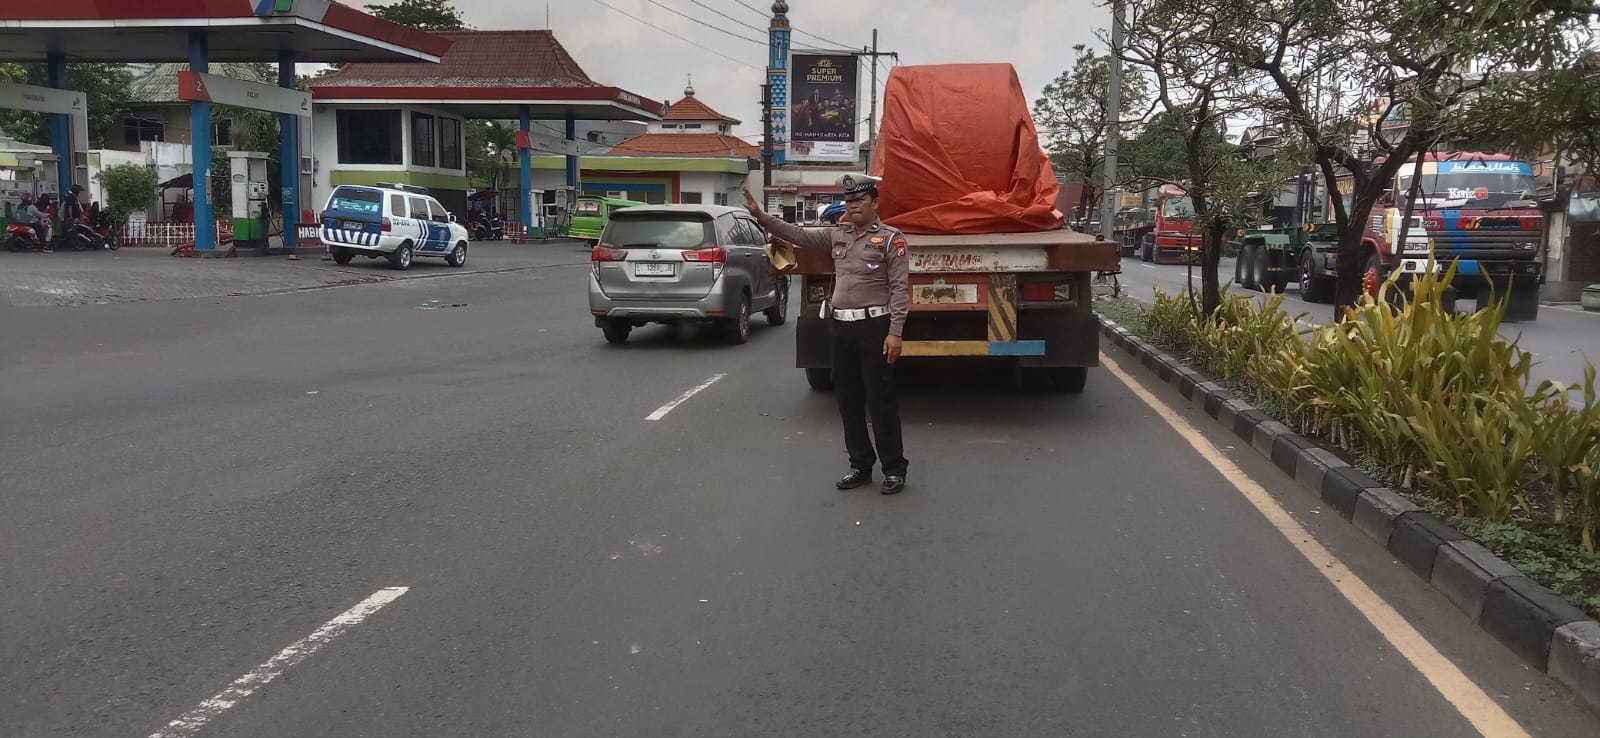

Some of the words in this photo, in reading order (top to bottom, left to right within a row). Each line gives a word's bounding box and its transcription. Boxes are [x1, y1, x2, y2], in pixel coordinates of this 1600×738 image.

[811, 67, 837, 75] SUPER
[806, 74, 842, 82] PREMIUM
[196, 82, 202, 92] 2
